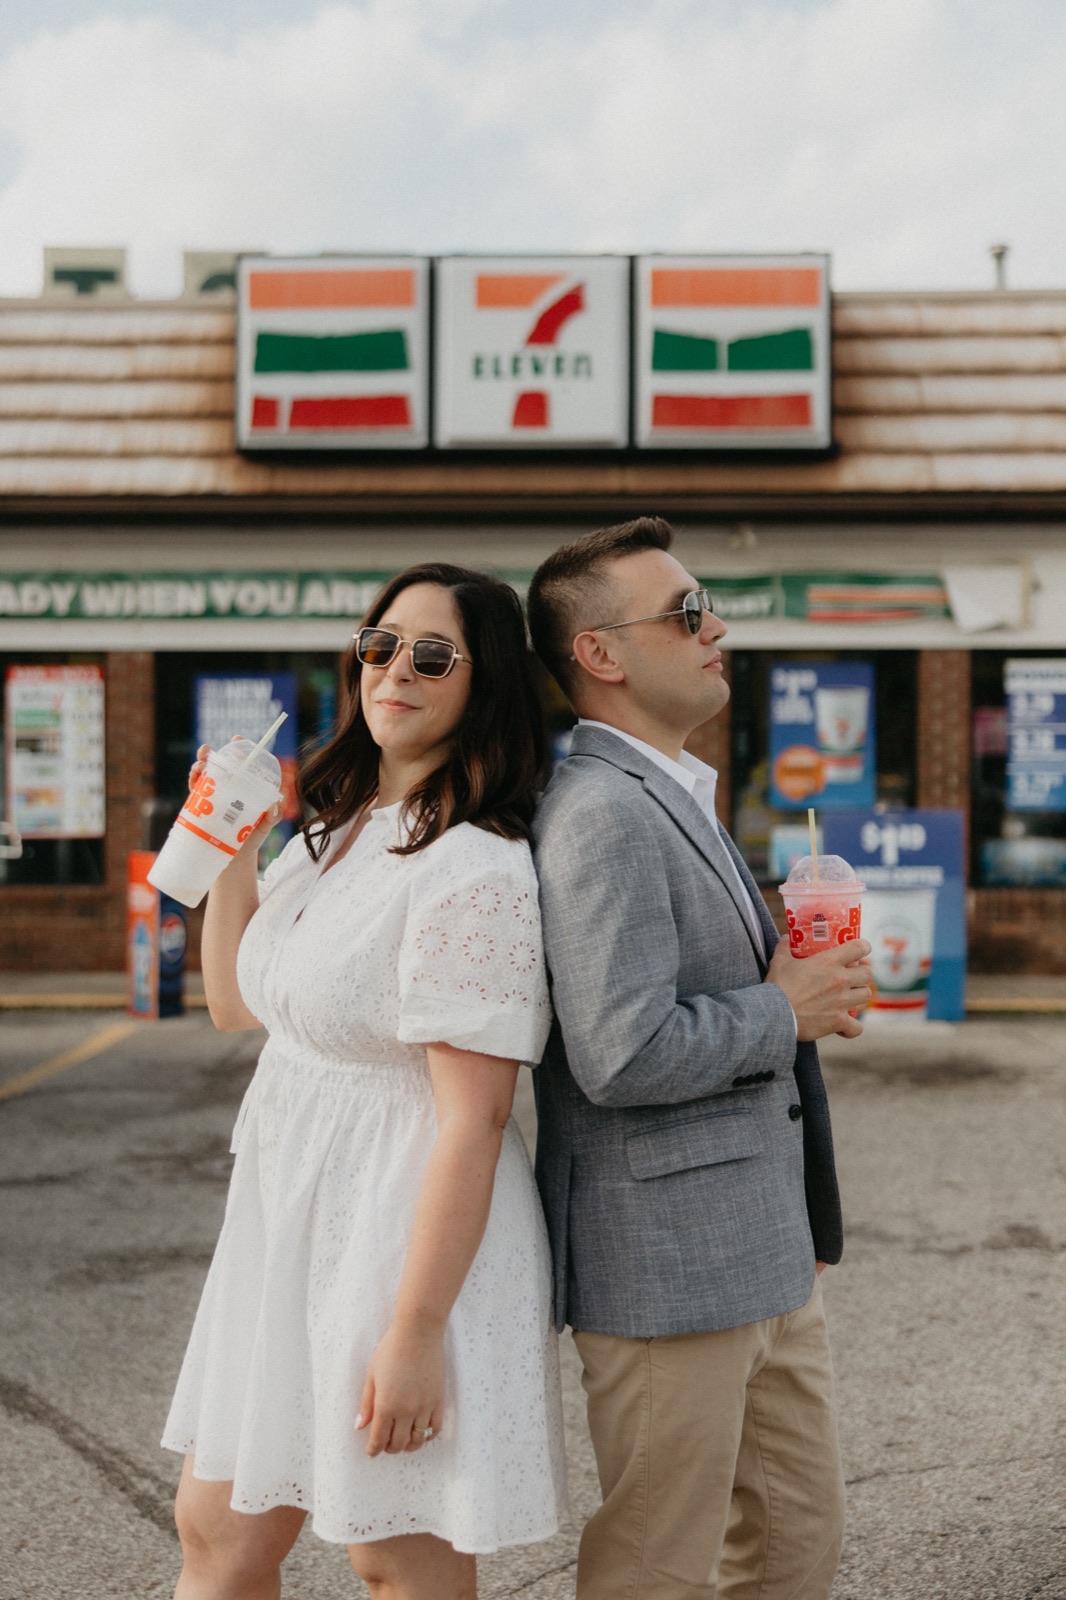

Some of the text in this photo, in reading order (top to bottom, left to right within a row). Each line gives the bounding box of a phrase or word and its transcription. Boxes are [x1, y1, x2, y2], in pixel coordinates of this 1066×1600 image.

[474, 273, 587, 428] 7
[81, 581, 206, 616] WHEN
[209, 580, 297, 616] YOU
